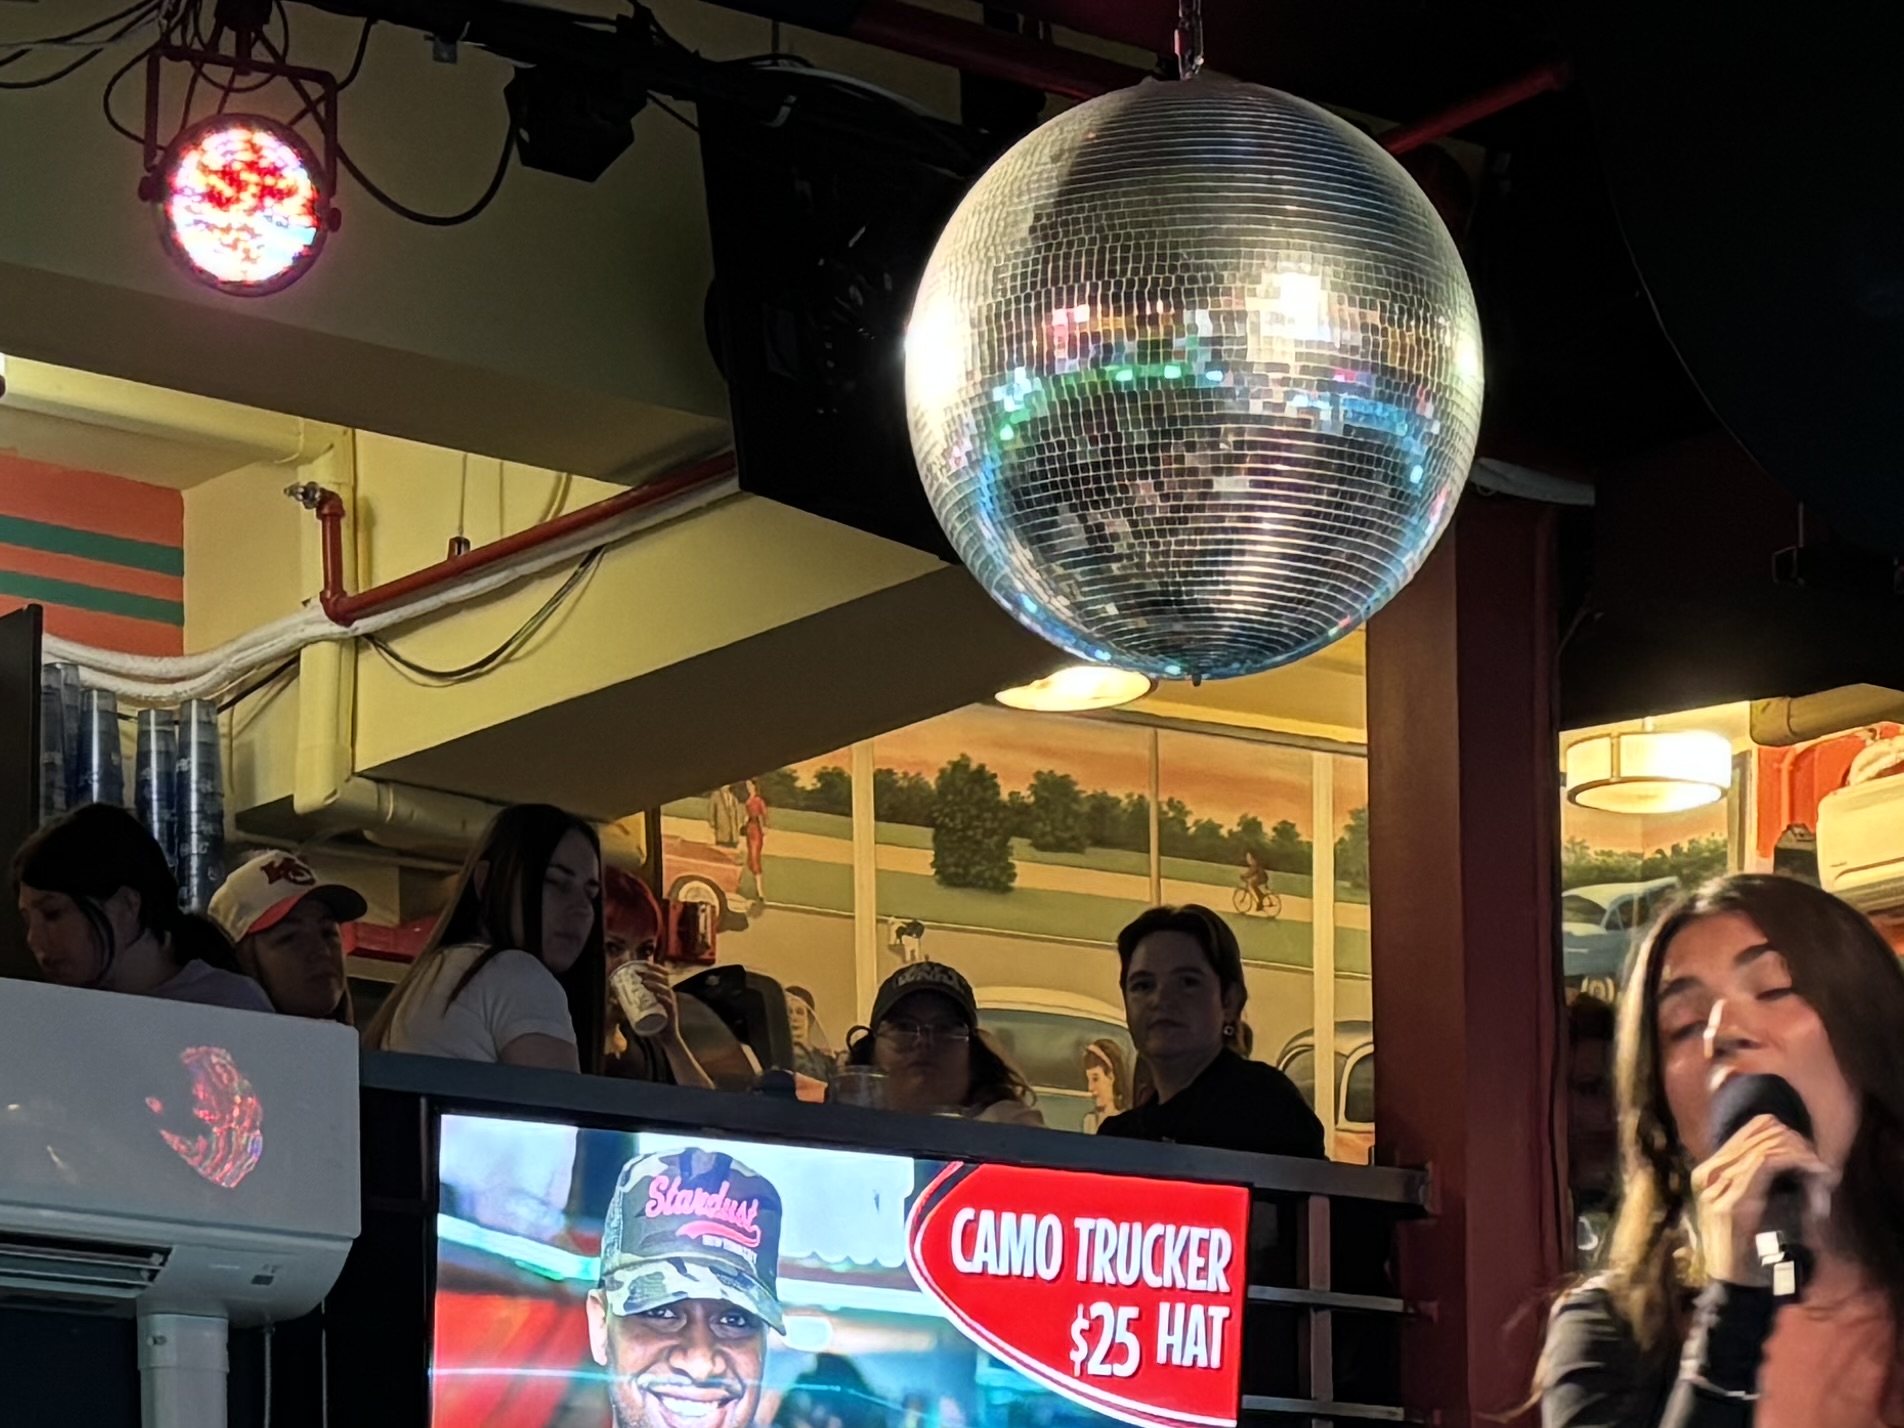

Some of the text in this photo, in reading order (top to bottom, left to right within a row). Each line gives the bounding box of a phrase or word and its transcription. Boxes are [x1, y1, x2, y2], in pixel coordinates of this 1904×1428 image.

[645, 1174, 761, 1233] Stardust
[951, 1207, 1233, 1293] CAMO TRUCKER
[1069, 1301, 1230, 1377] $25 HAT
